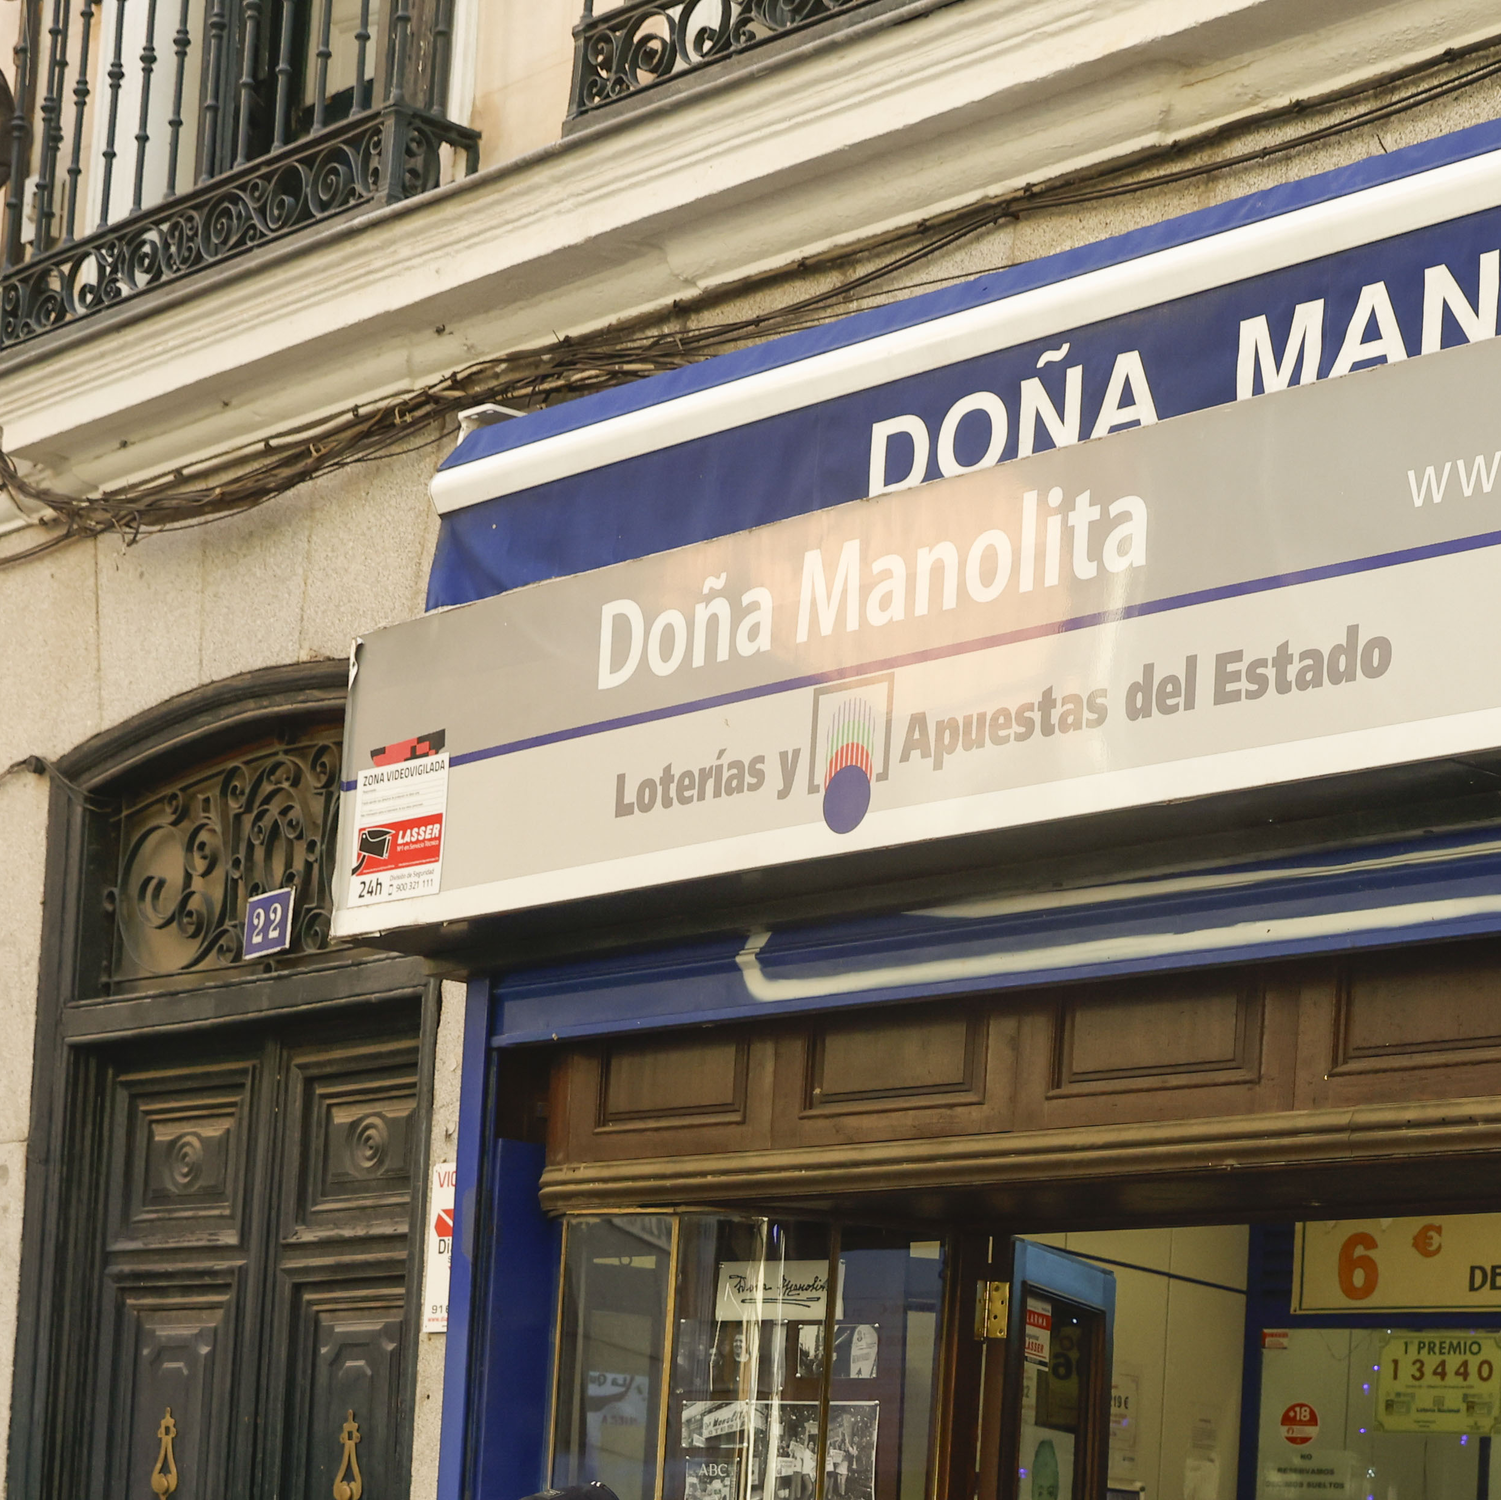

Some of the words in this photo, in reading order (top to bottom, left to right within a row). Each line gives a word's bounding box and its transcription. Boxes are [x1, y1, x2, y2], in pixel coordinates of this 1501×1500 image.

[868, 341, 1159, 498] DOÑA
[597, 571, 773, 691] Doña
[796, 485, 1148, 644] Manolita
[614, 748, 765, 818] Loterías
[776, 745, 801, 800] y
[899, 684, 1108, 771] Apuestas
[1125, 654, 1198, 722] del
[1213, 623, 1393, 707] Estado
[363, 773, 385, 787] ZONA
[387, 760, 445, 781] VIDEOVIGILADA
[397, 824, 441, 844] LASSER
[389, 873, 406, 881] División
[413, 868, 435, 878] Seguridad
[358, 878, 383, 898] 24h
[396, 882, 408, 892] 900
[409, 881, 420, 890] 321
[422, 879, 434, 888] 111
[252, 903, 282, 944] 22
[1338, 1232, 1378, 1300] 6
[1412, 1223, 1442, 1258] €
[1417, 1340, 1482, 1356] PREMIO
[1391, 1358, 1494, 1382] 13440
[1289, 1406, 1310, 1421] +18
[1300, 1453, 1312, 1461] NO
[698, 1463, 728, 1477] ABC
